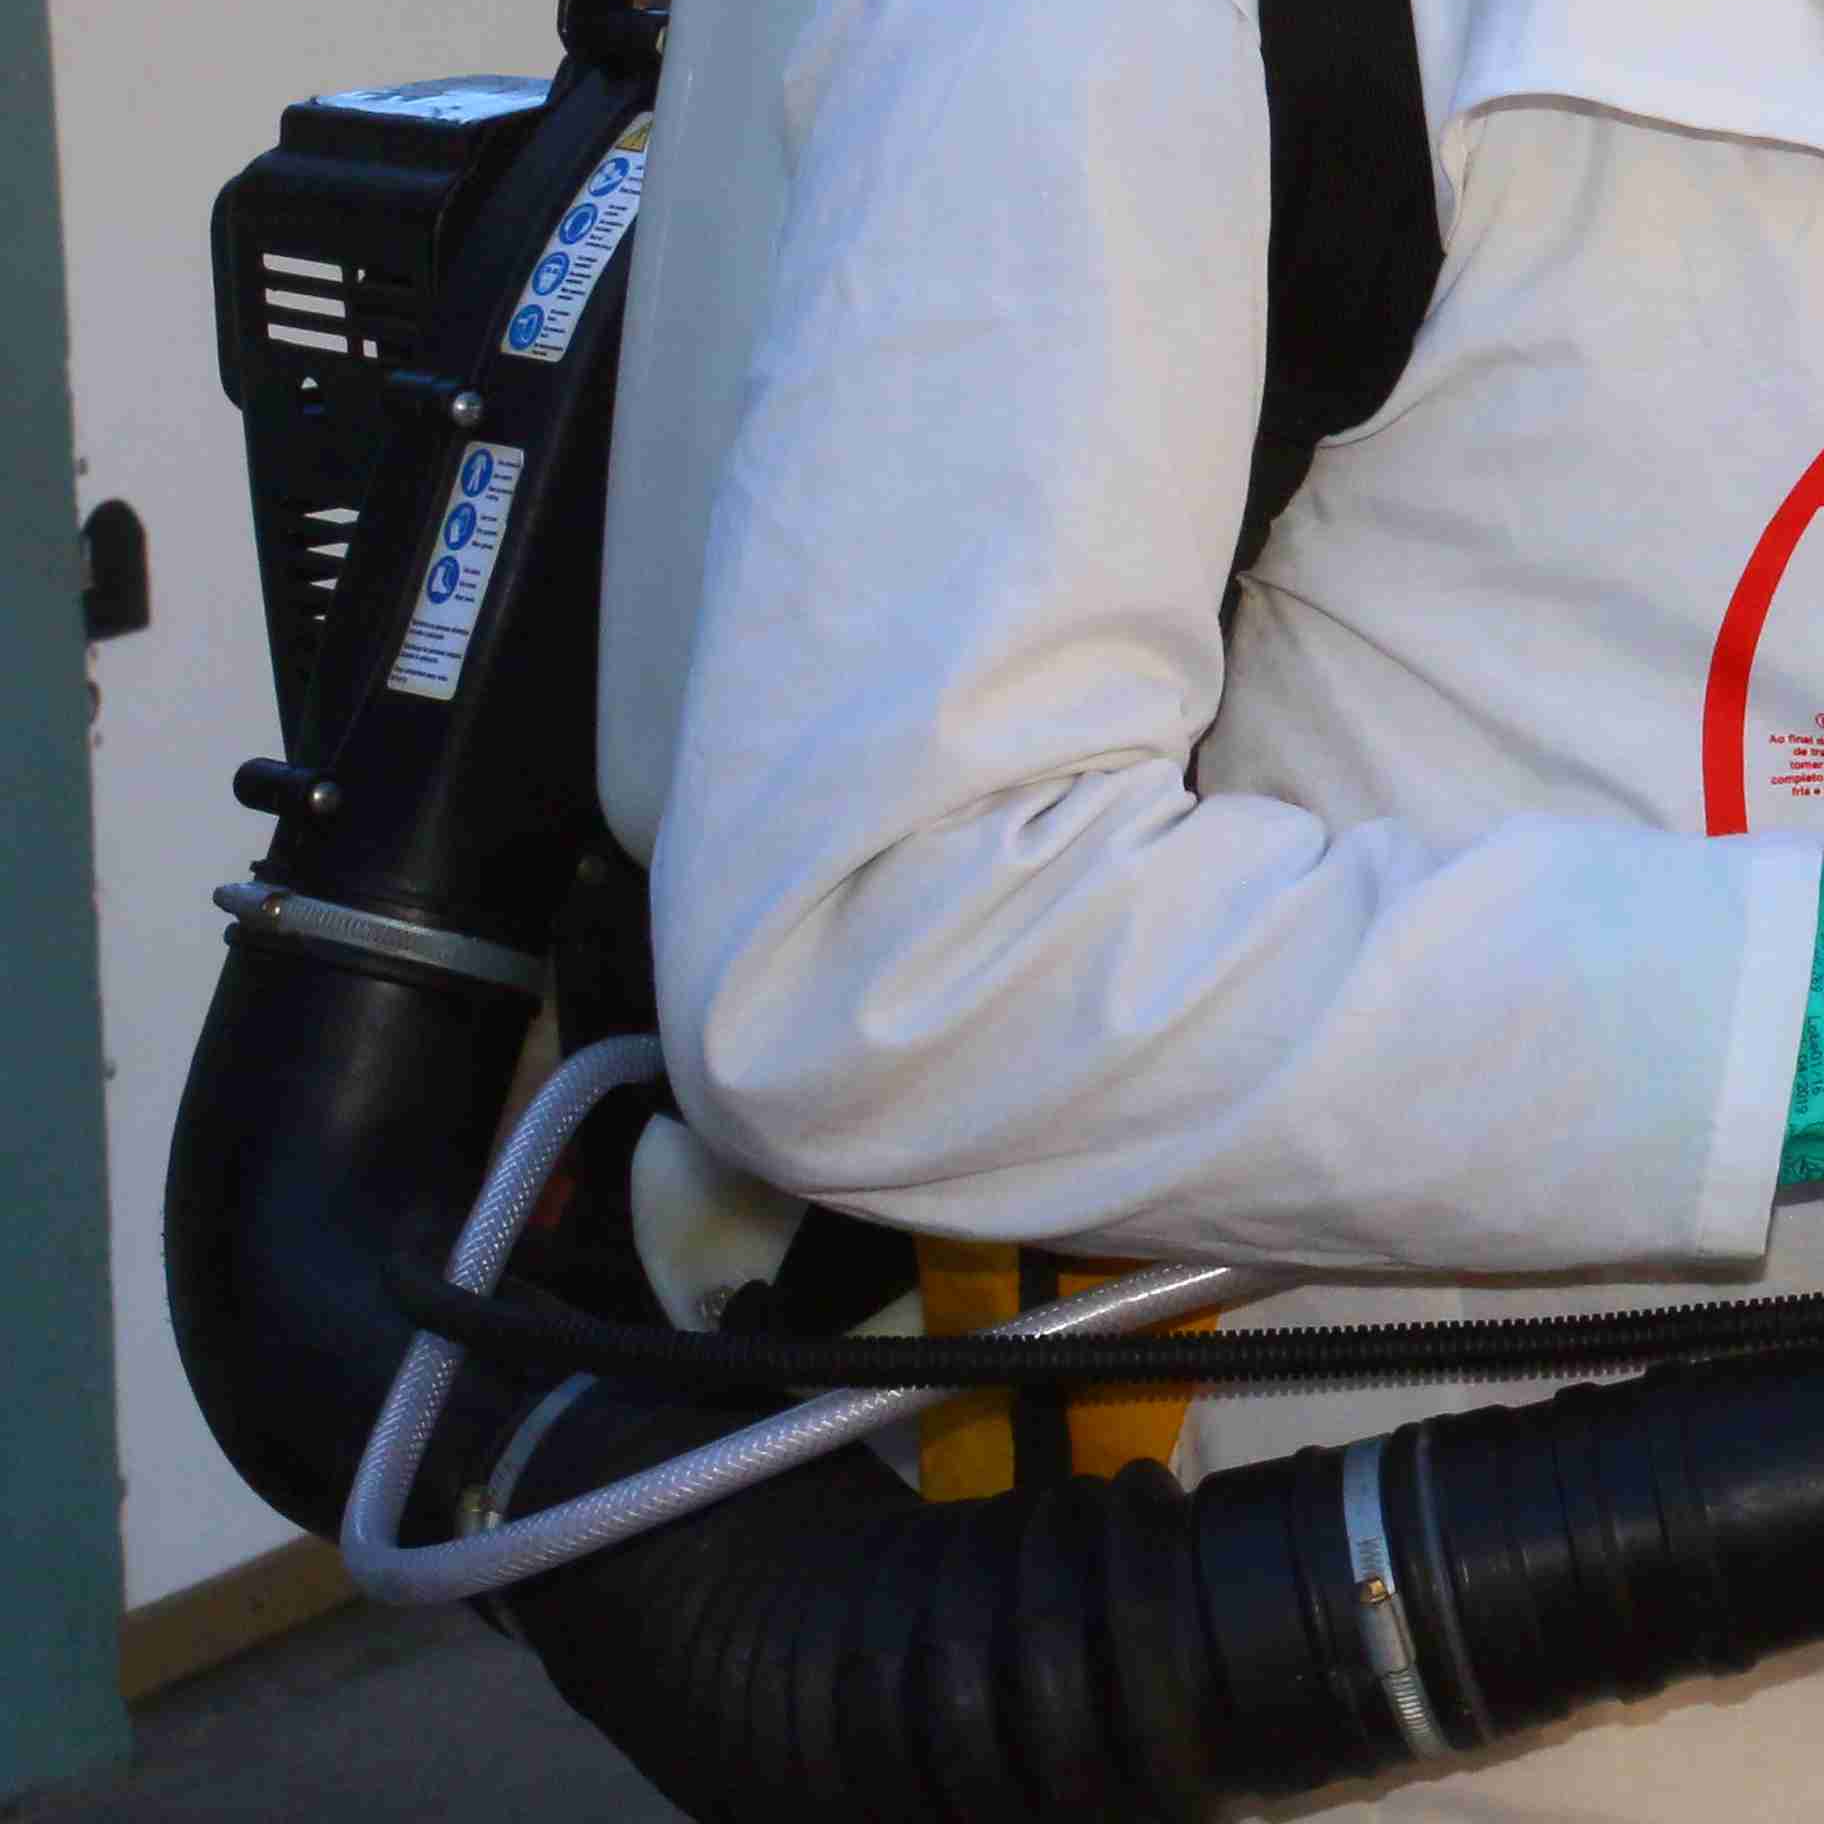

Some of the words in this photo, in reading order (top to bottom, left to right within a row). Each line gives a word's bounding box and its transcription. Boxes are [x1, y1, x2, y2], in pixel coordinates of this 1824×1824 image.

[1769, 735, 1785, 745] Ao
[1788, 734, 1814, 745] final
[1793, 747, 1808, 757] de
[1791, 761, 1824, 770] tomar
[1770, 774, 1824, 785] completo
[1792, 785, 1811, 797] fria
[1813, 787, 1822, 795] e
